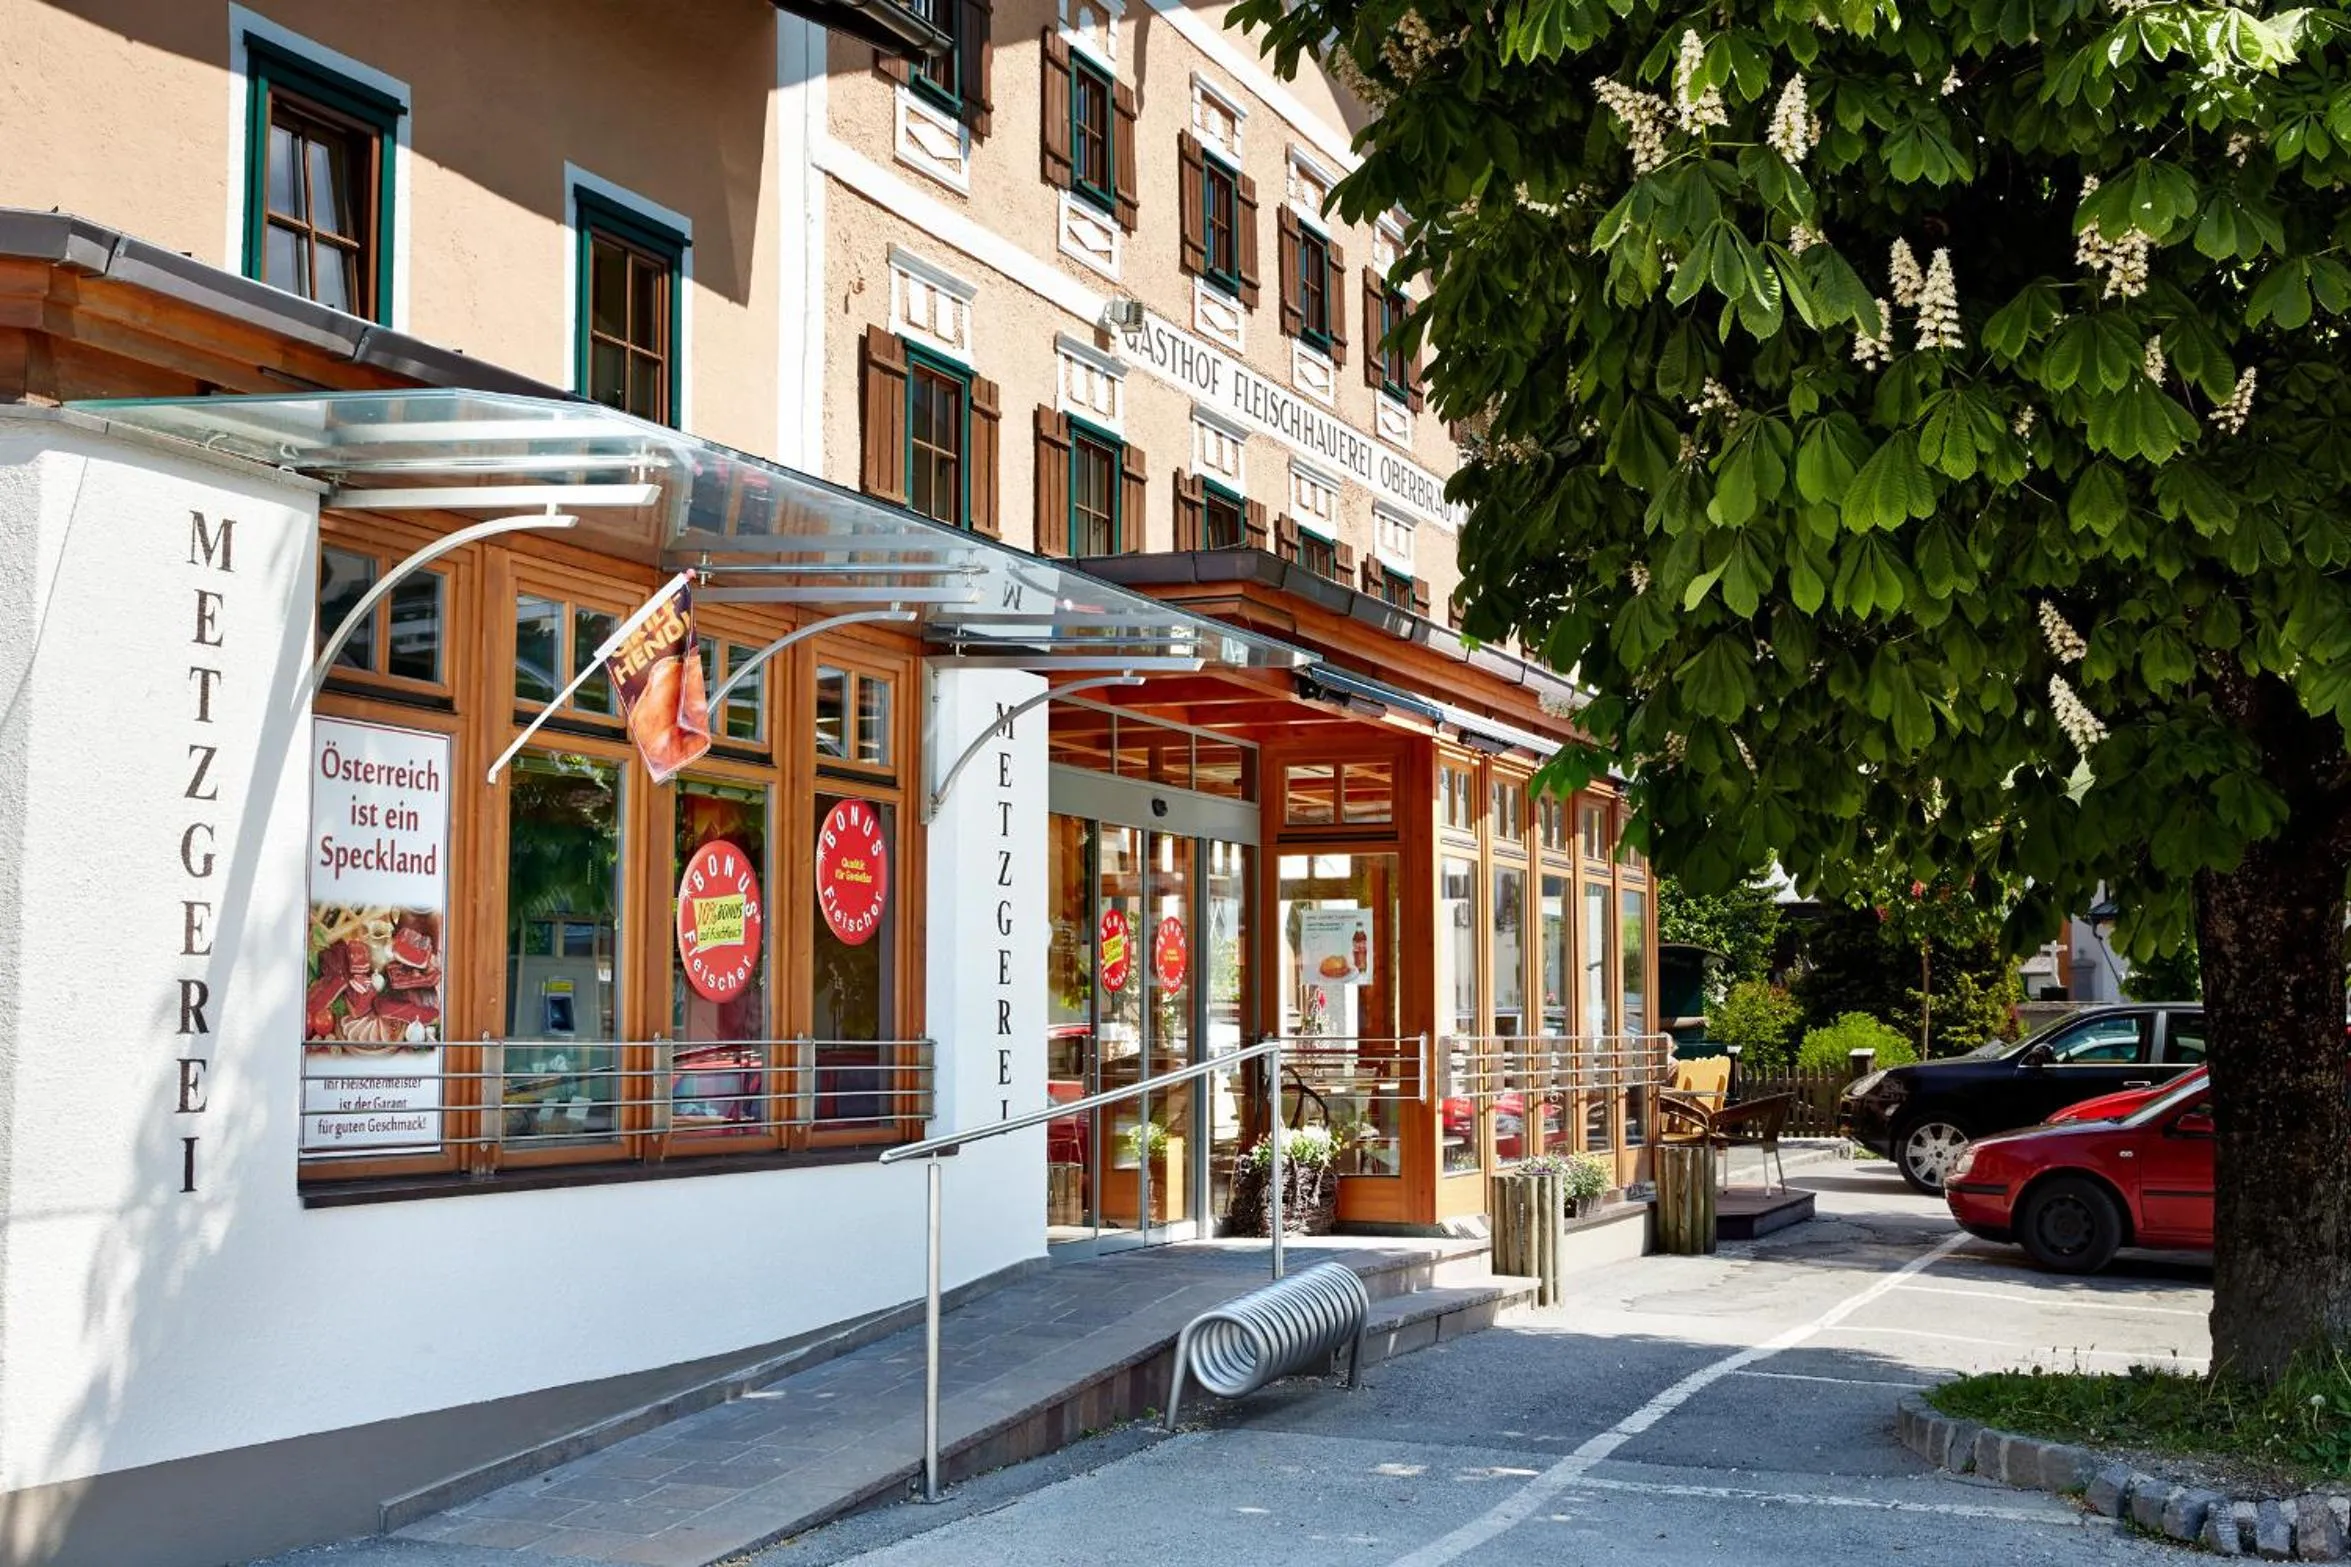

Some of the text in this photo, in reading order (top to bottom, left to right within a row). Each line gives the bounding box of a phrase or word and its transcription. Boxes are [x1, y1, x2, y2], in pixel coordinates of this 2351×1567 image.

[1125, 319, 1221, 395] GASTHOF
[1234, 370, 1373, 481] FLEISCHHAUEREI
[321, 740, 439, 792] Österreich
[351, 794, 418, 832] ist ein
[825, 805, 883, 857] BONUS
[174, 509, 237, 1194] METZGEREI
[320, 835, 436, 880] Speckland
[692, 854, 757, 918] BONUS
[824, 886, 883, 932] Fleischer
[995, 702, 1015, 1135] METZGEREI
[684, 929, 752, 991] Fleischer
[318, 1116, 427, 1139] für guten Geschmack!
[355, 1095, 371, 1111] der
[374, 1097, 408, 1110] Garant
